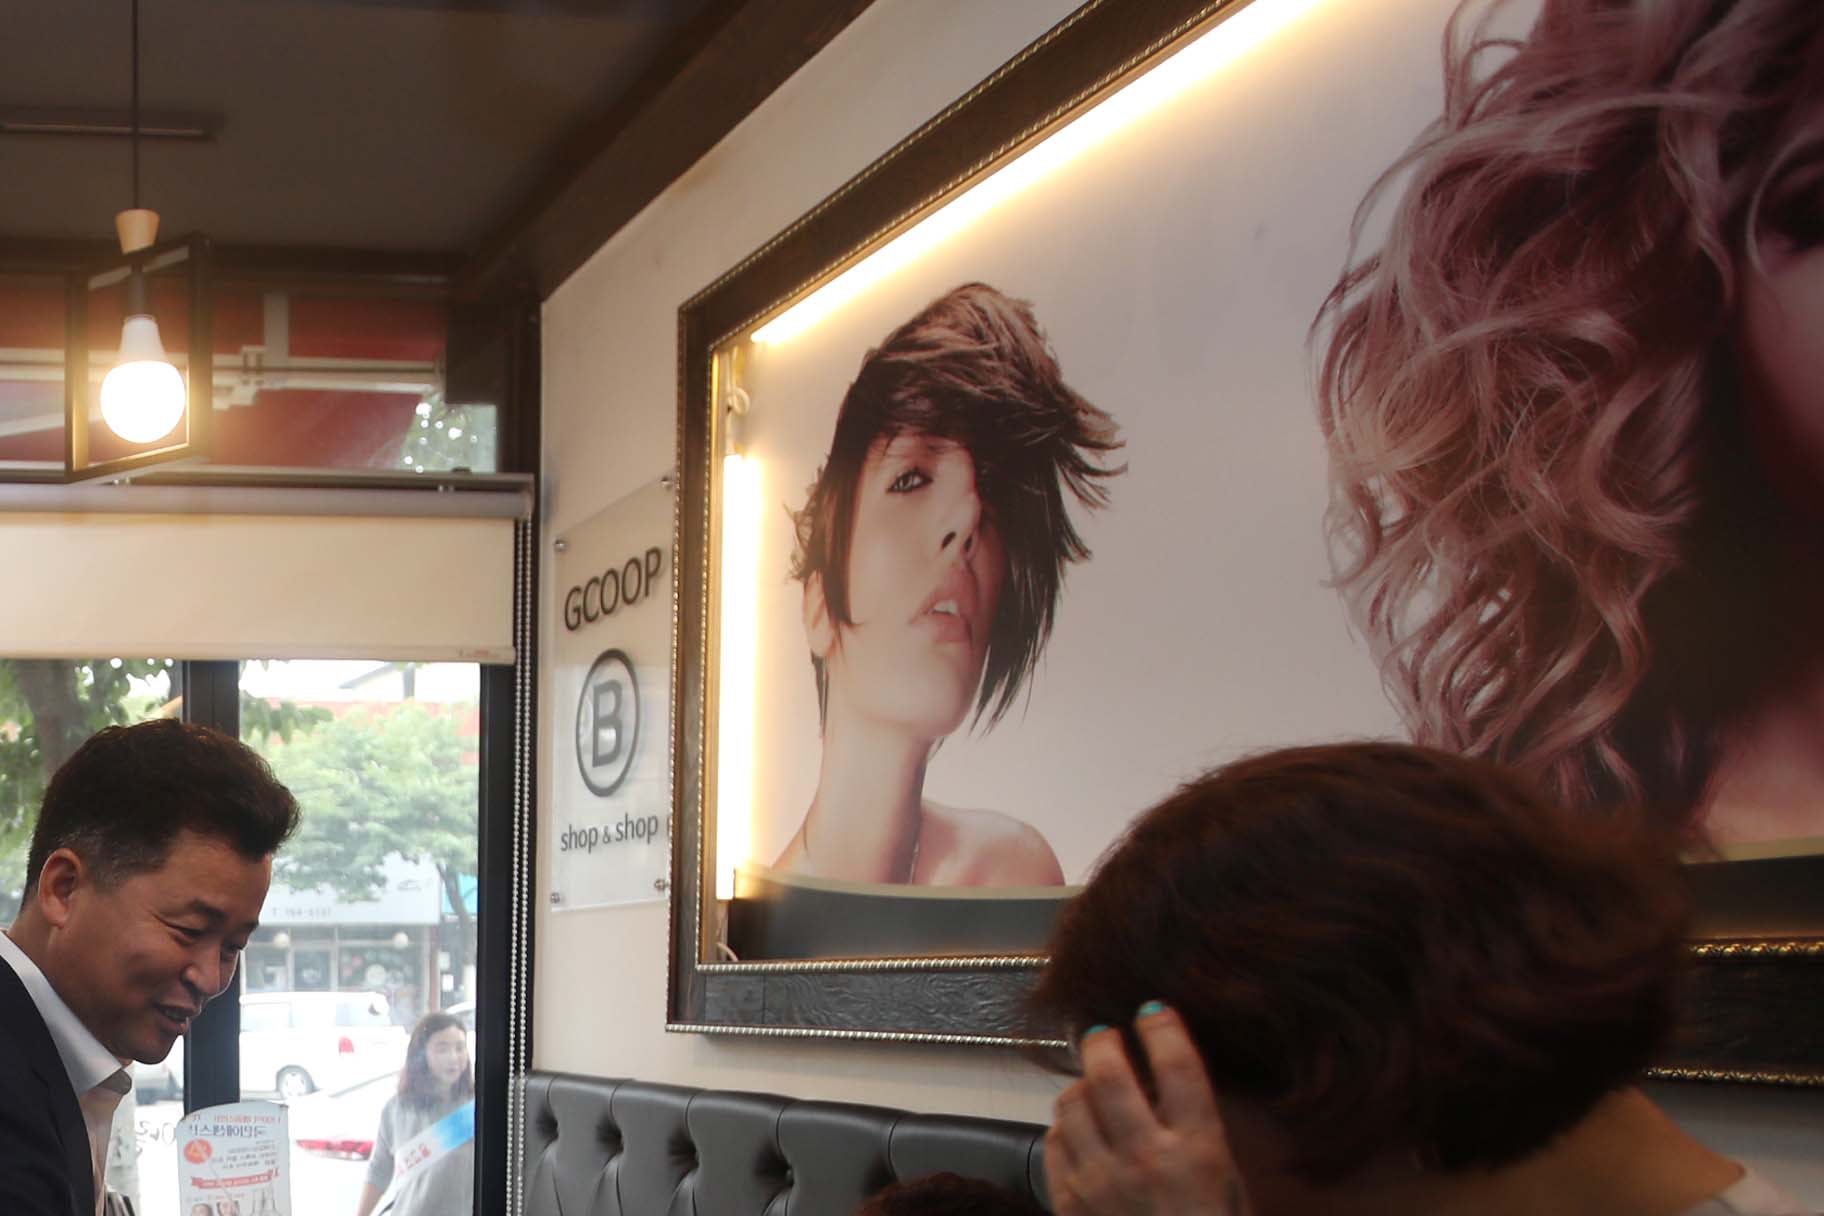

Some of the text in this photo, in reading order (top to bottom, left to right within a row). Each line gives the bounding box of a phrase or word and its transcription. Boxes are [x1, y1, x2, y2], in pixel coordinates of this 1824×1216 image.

[564, 546, 663, 632] GCOOP
[560, 820, 598, 852] shop
[615, 813, 660, 847] shop
